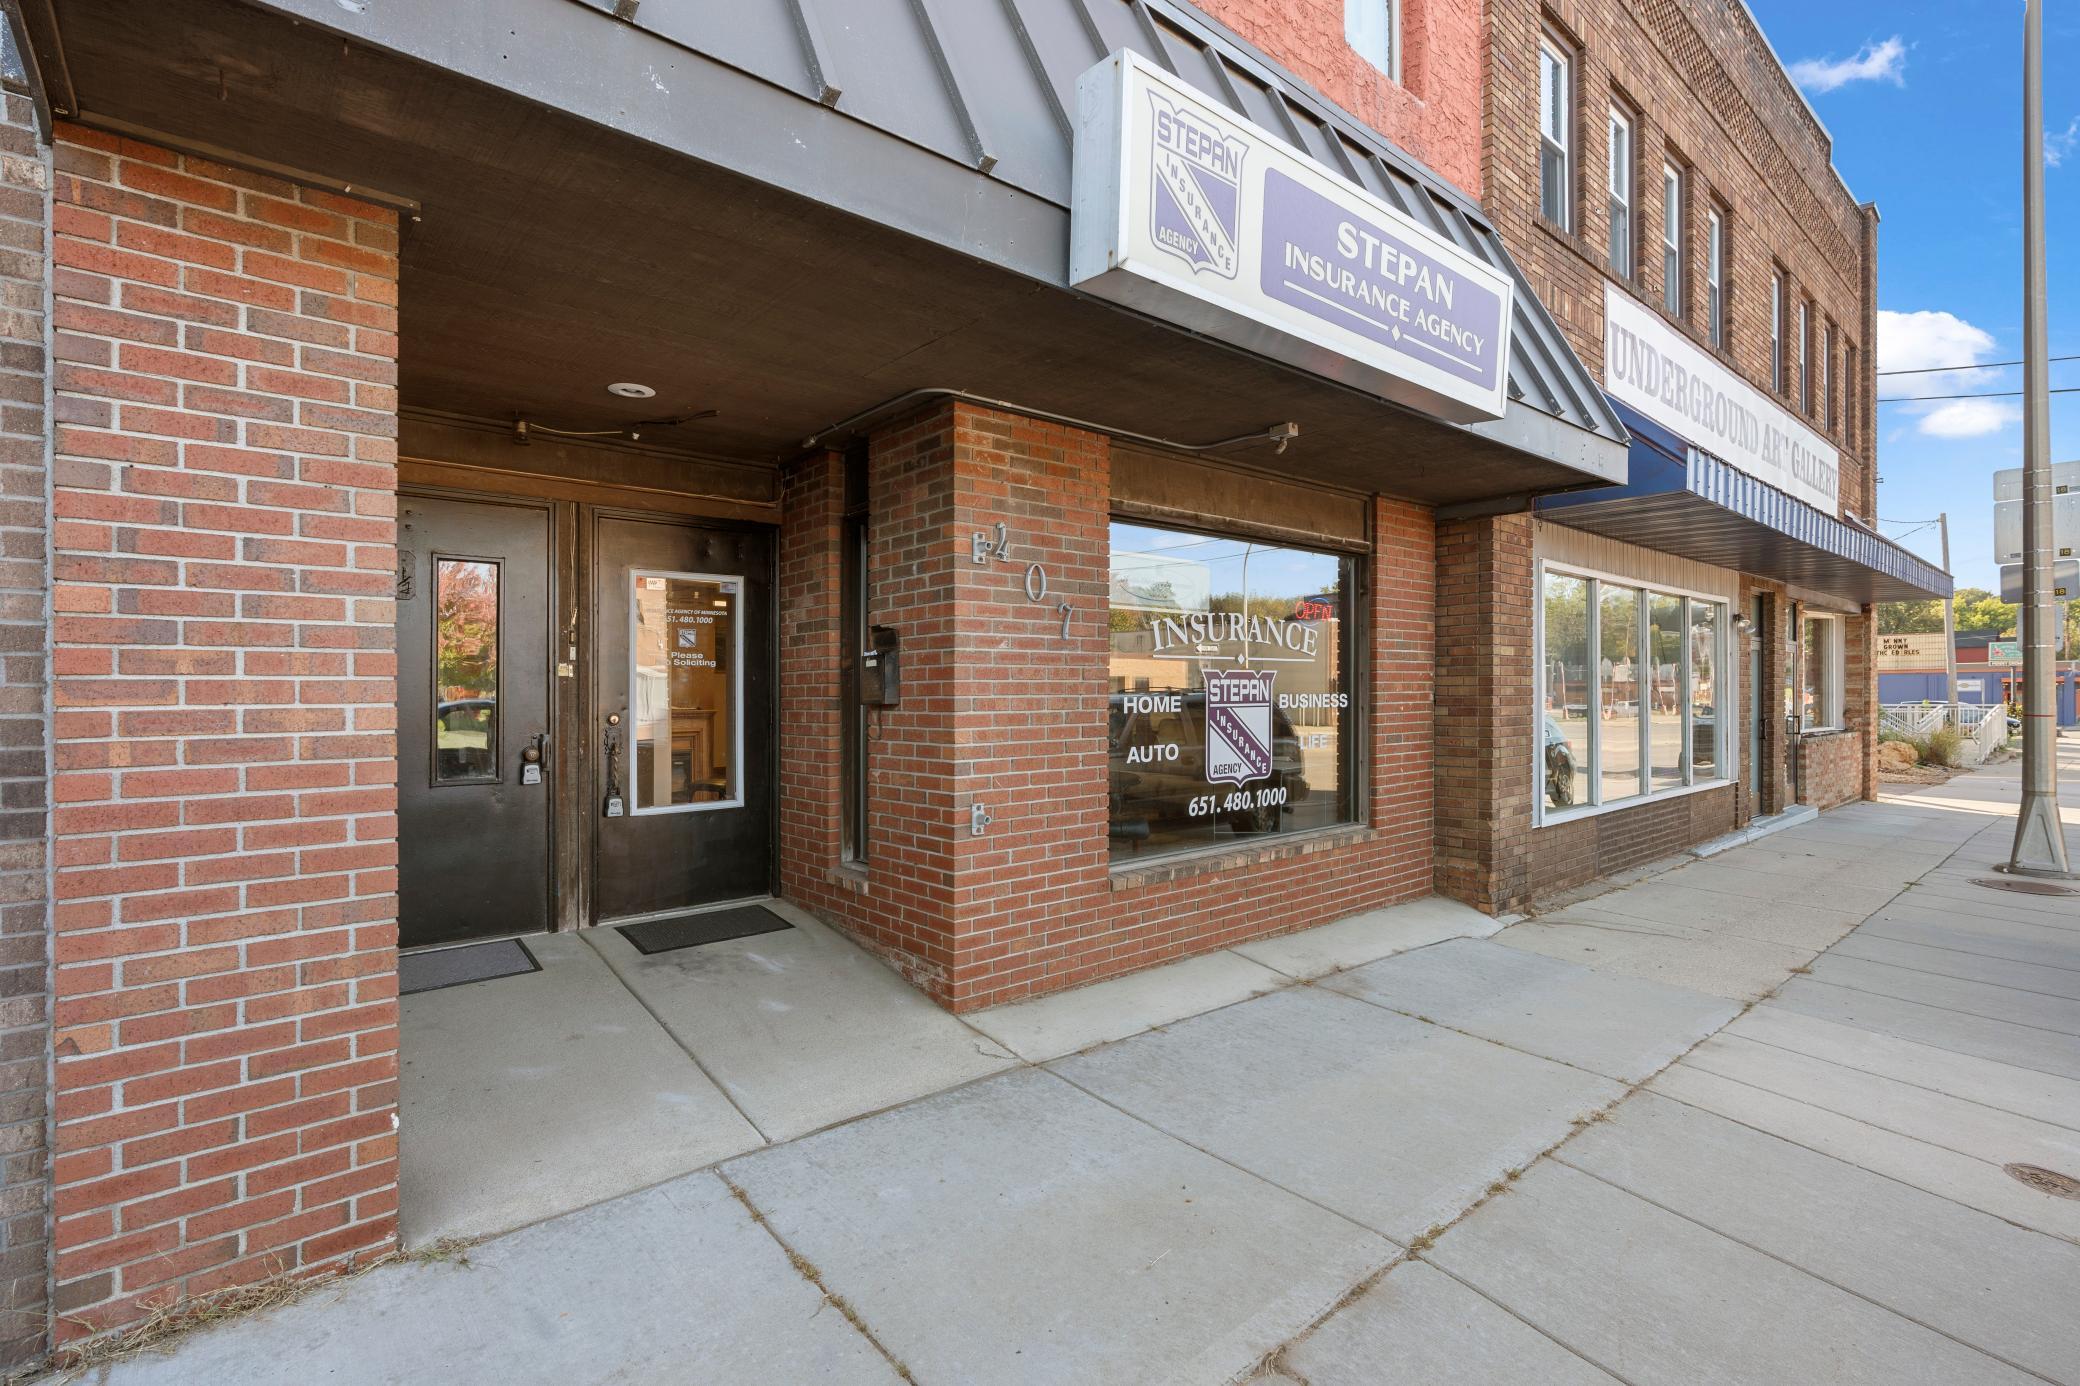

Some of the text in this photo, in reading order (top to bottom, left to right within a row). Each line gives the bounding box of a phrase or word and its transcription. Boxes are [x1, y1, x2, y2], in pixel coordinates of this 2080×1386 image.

[1157, 109, 1238, 179] STEPAN
[1166, 153, 1231, 271] INSURANCE
[1158, 225, 1199, 255] AGENCY
[1337, 221, 1454, 310] STEPAN
[1285, 241, 1485, 356] INSURANCE AGENCY
[1610, 320, 1759, 456] UNDERGROUND
[1791, 440, 1838, 501] GALLERY
[661, 615, 713, 624] 51.480.1000
[1150, 612, 1318, 656] INSURANCE
[671, 651, 704, 659] Please
[673, 658, 717, 668] Soliciting
[1209, 679, 1270, 702] STEPAN
[1279, 693, 1348, 709] BUSINESS
[1123, 696, 1182, 714] HOME
[1126, 743, 1180, 764] AUTO
[1216, 709, 1267, 774] INSURANCE
[1299, 734, 1329, 750] LIFE
[1212, 763, 1242, 776] AGENCY
[1188, 786, 1287, 817] 651.480.1000
